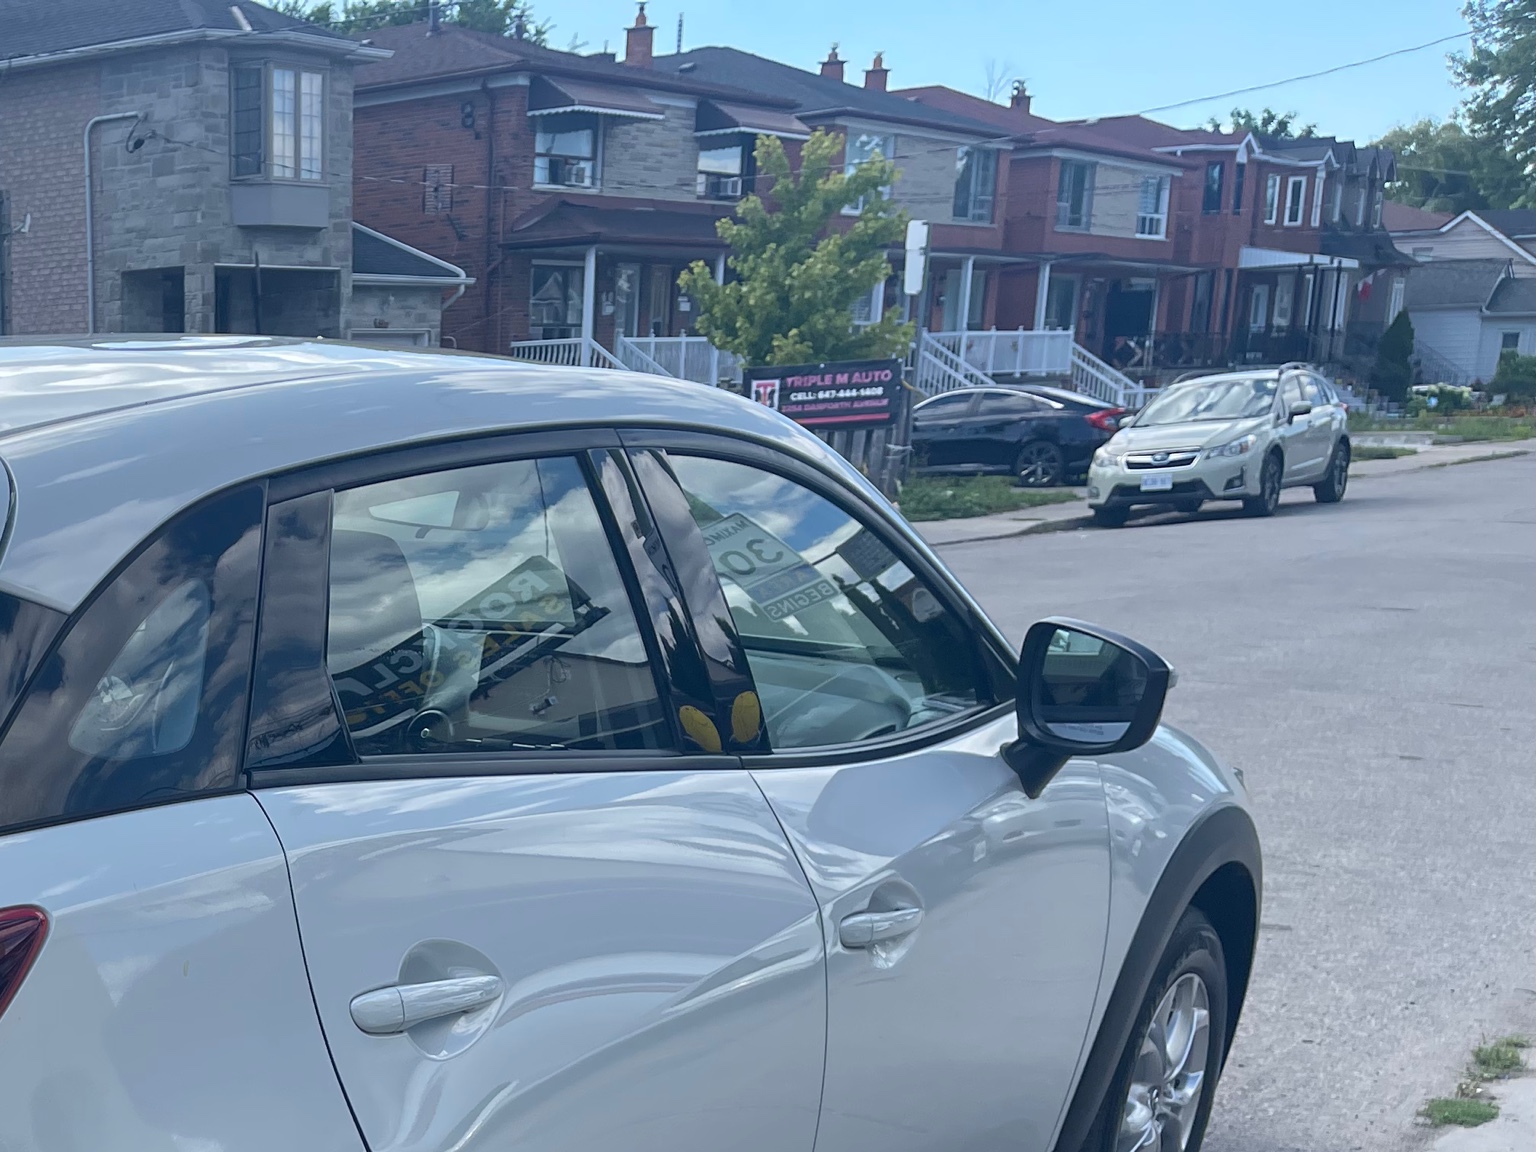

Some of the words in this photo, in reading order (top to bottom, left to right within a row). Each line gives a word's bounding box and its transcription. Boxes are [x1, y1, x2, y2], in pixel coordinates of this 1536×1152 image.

[786, 375, 833, 388] TRIPLE
[836, 373, 849, 385] M
[851, 369, 893, 383] AUTO
[790, 391, 817, 401] CELL:
